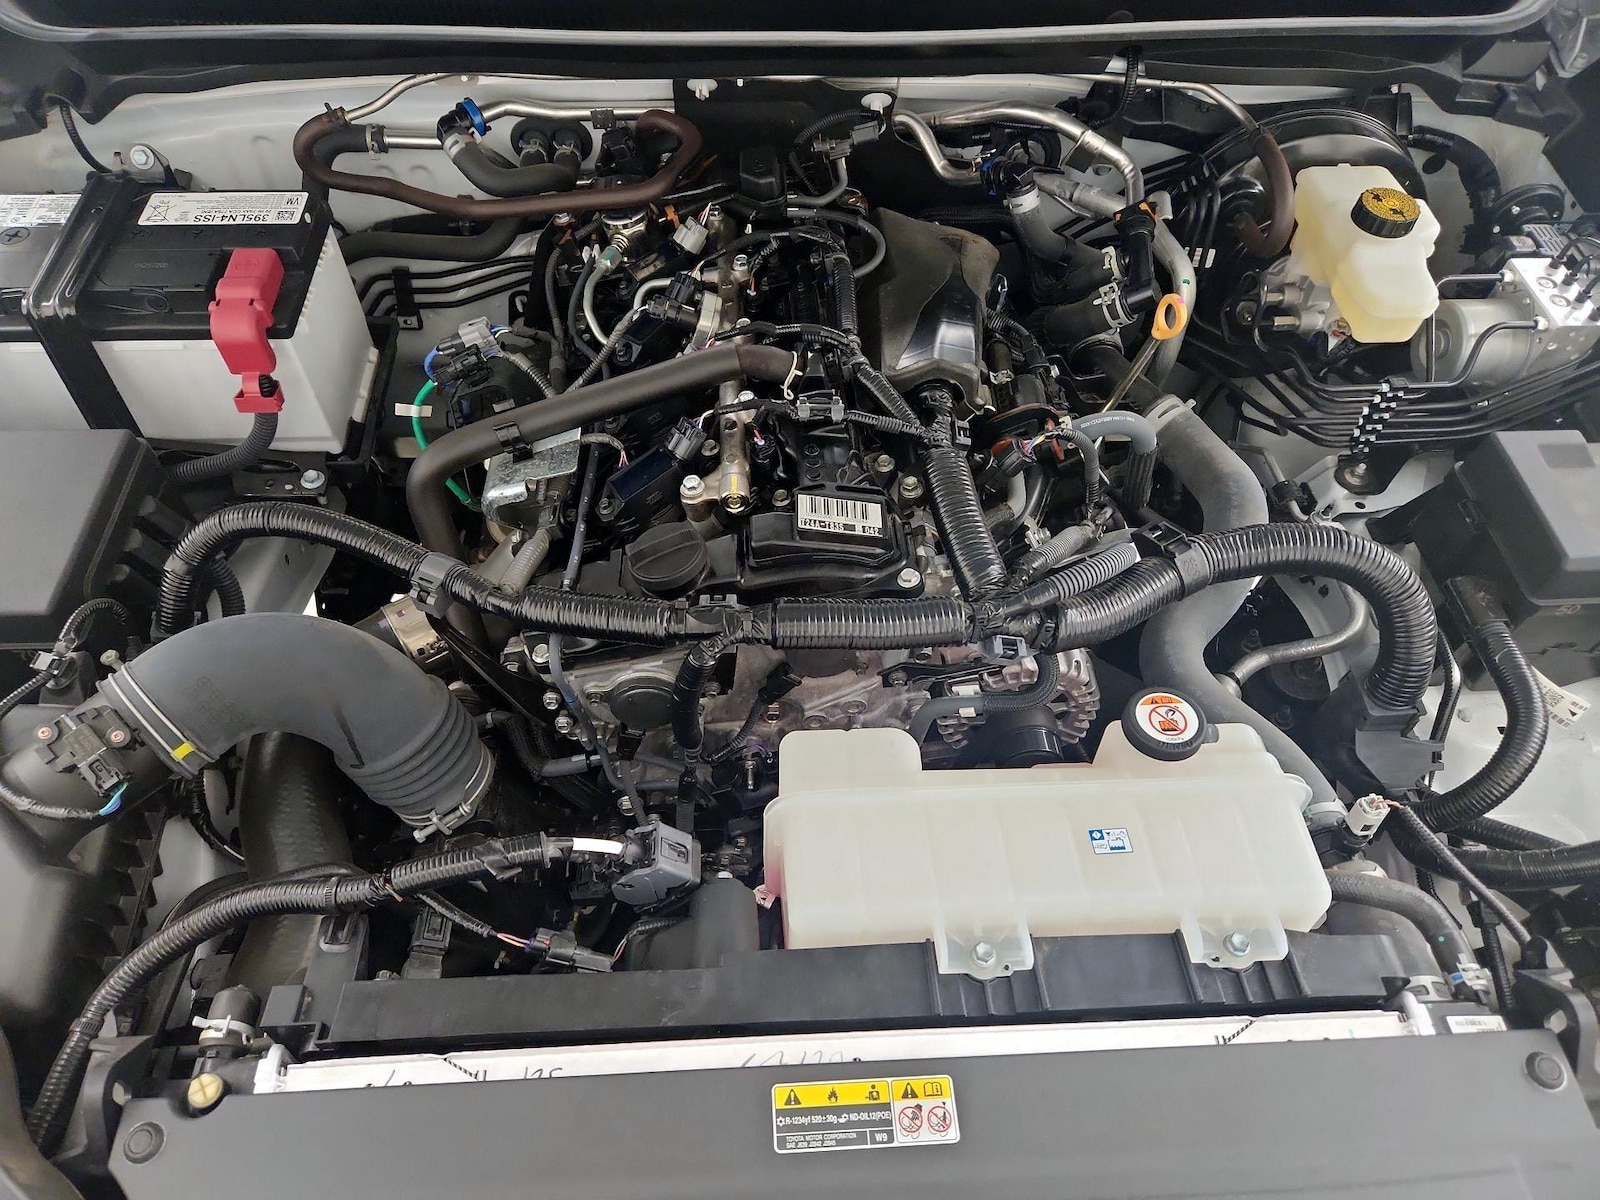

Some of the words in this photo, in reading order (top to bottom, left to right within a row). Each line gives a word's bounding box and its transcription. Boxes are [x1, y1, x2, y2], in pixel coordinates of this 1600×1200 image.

[286, 197, 299, 206] VM
[193, 213, 270, 223] 395LN4-ISS
[805, 1133, 822, 1141] MOTOR
[823, 1132, 857, 1140] CORPORATION
[874, 1132, 888, 1142] W9
